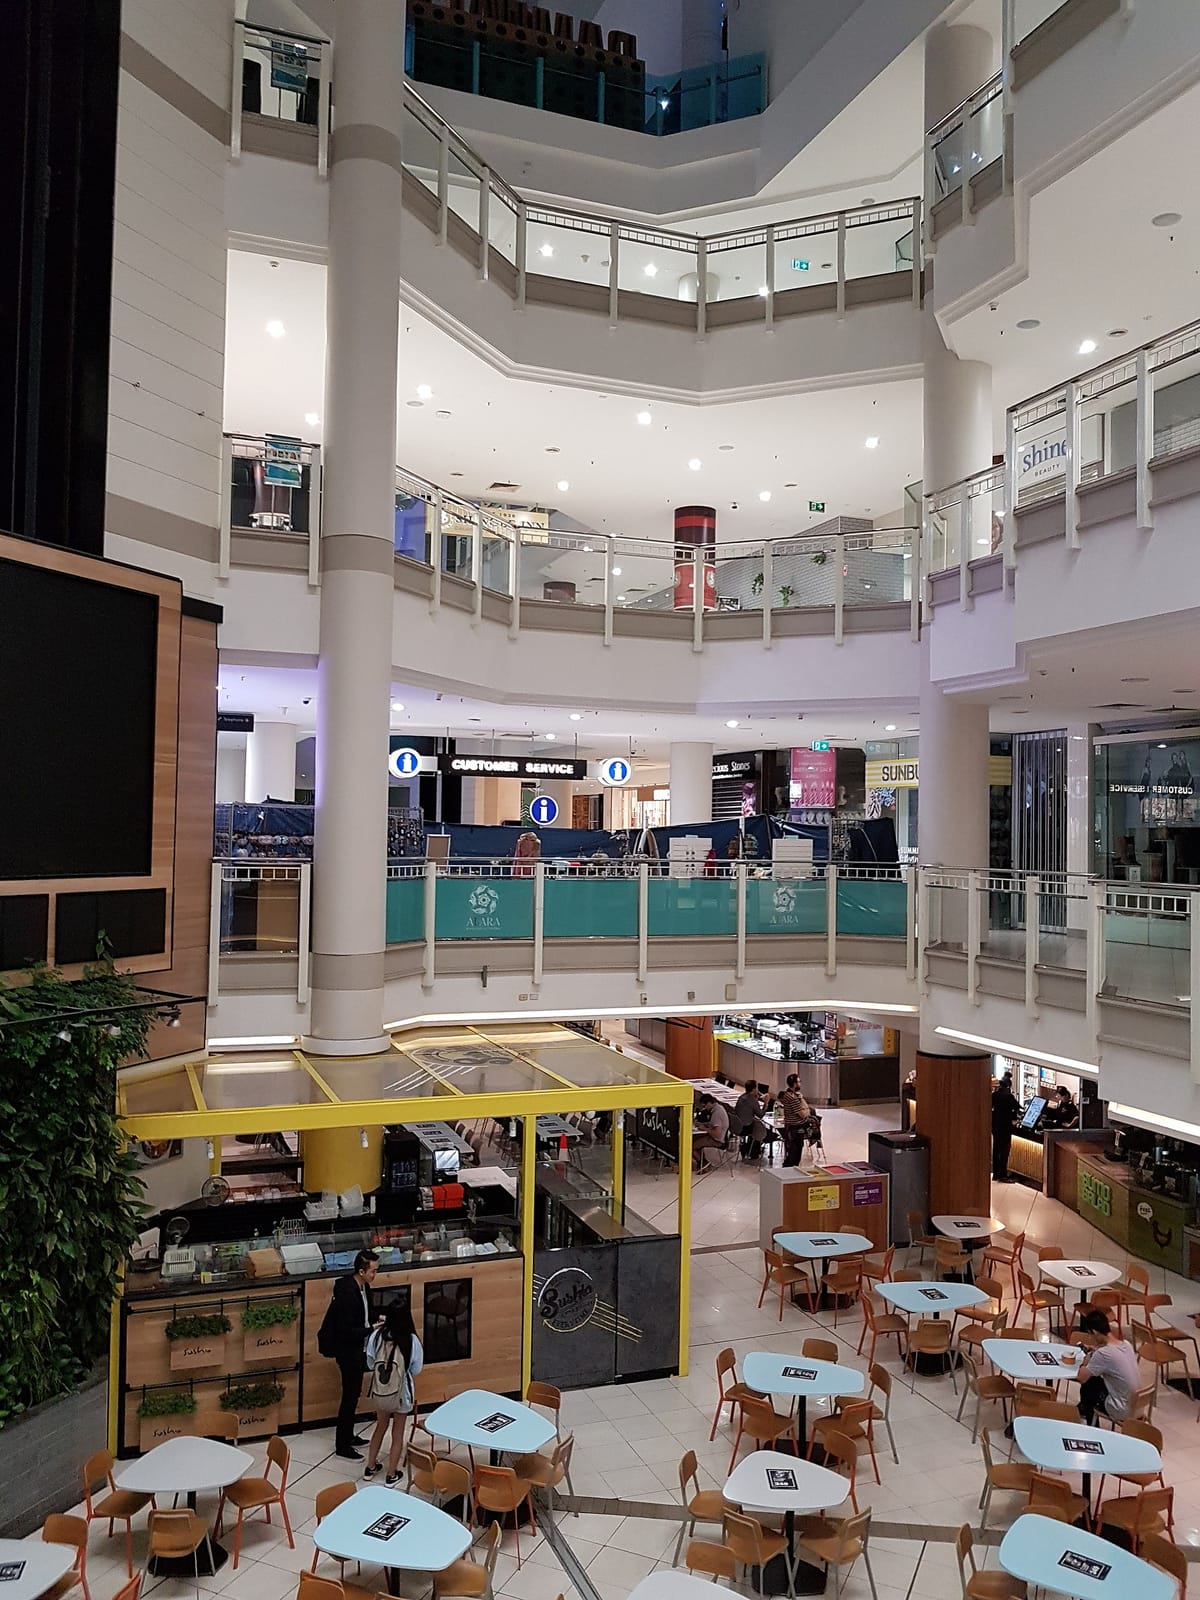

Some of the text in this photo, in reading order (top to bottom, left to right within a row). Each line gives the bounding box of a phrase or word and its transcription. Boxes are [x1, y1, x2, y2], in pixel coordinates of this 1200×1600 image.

[1022, 439, 1067, 473] shine
[1034, 464, 1060, 477] BEAUTY
[451, 759, 574, 775] CUSTOMER SERVICE
